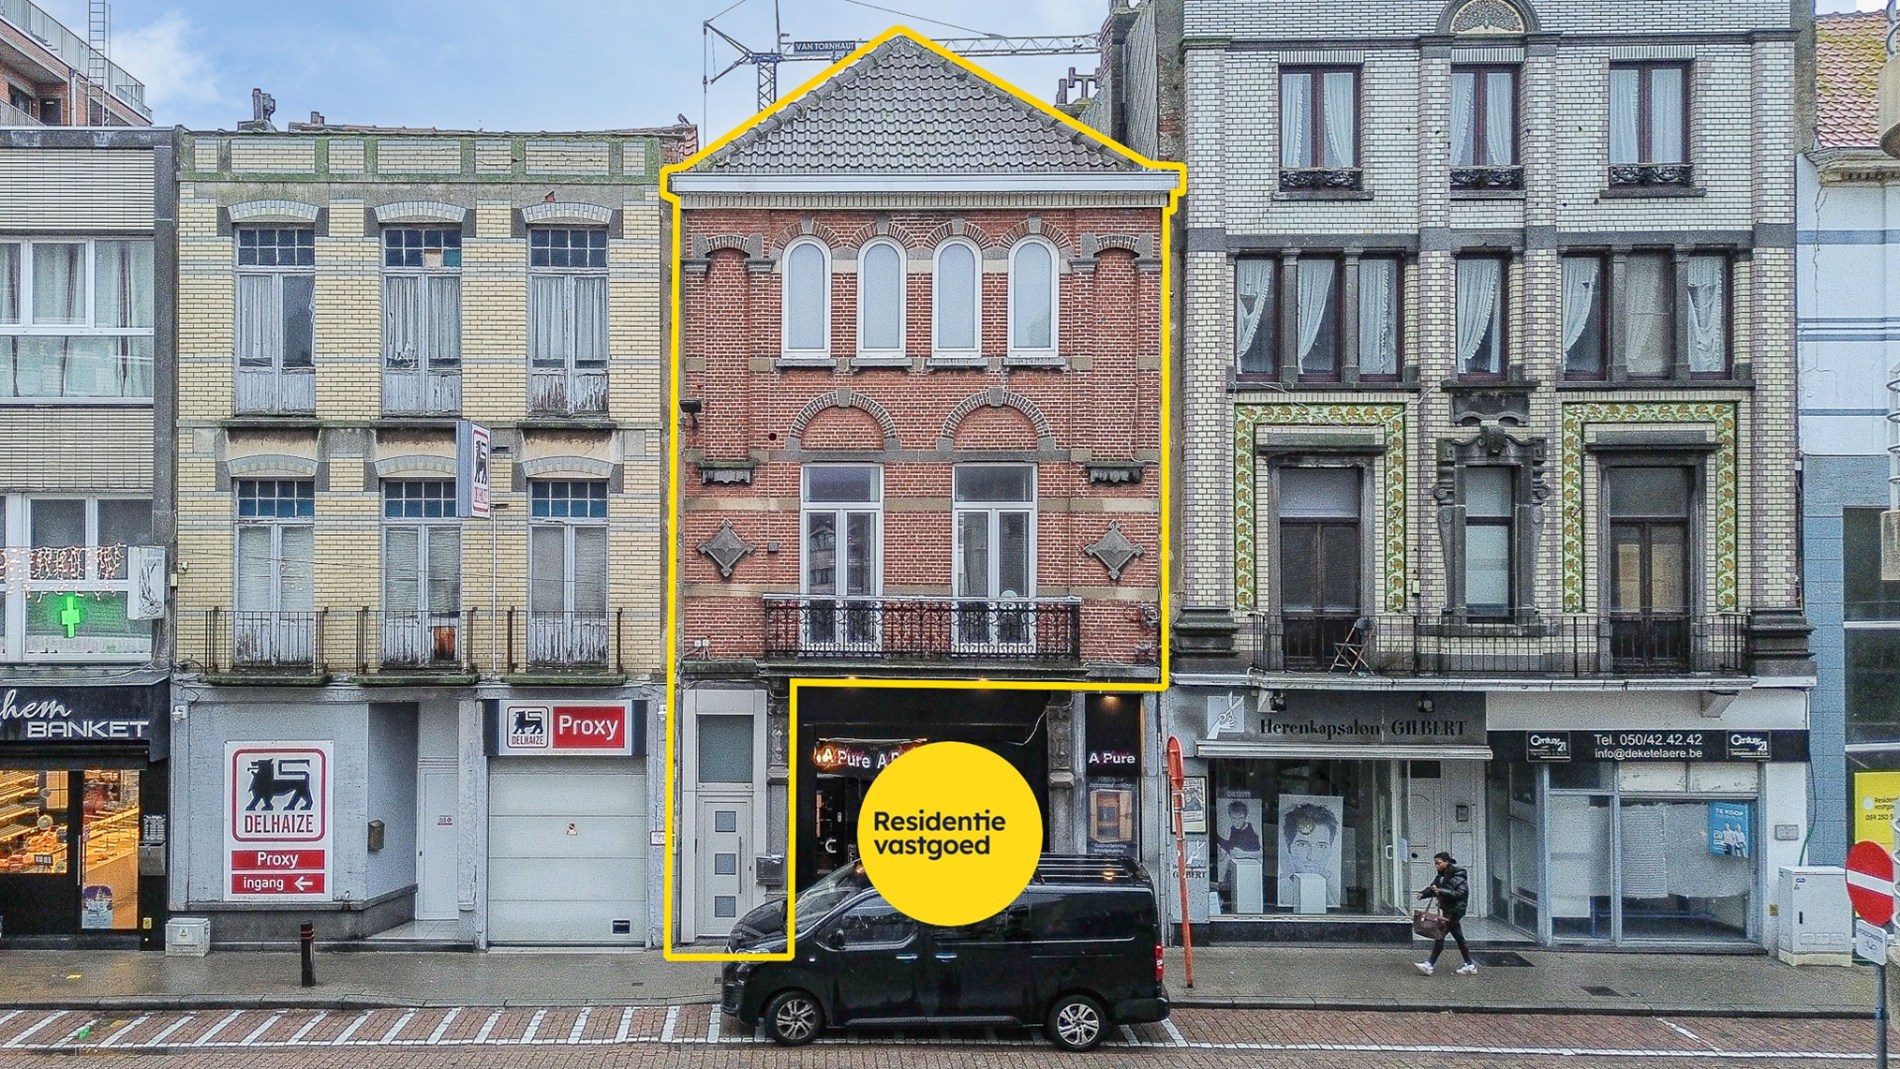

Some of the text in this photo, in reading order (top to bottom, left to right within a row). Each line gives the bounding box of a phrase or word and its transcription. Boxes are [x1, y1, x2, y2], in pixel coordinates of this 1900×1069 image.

[796, 42, 854, 50] VAN TORNHAUT
[0, 689, 72, 719] hem
[27, 720, 149, 738] BANKET
[558, 714, 619, 741] Proxy
[1260, 719, 1468, 740] Herenkapsalon GILBERT
[511, 735, 544, 746] DELHAIZE
[1557, 741, 1568, 751] 21
[1593, 733, 1703, 746] Tel. 050/42.42.42
[1757, 741, 1768, 751] 21
[837, 750, 871, 768] Pure
[1088, 752, 1136, 764] A Pure
[1594, 748, 1703, 761] info@deketelaere.be
[244, 814, 314, 834] DELHAIZE
[257, 851, 299, 869] Proxy
[243, 876, 284, 891] ingang
